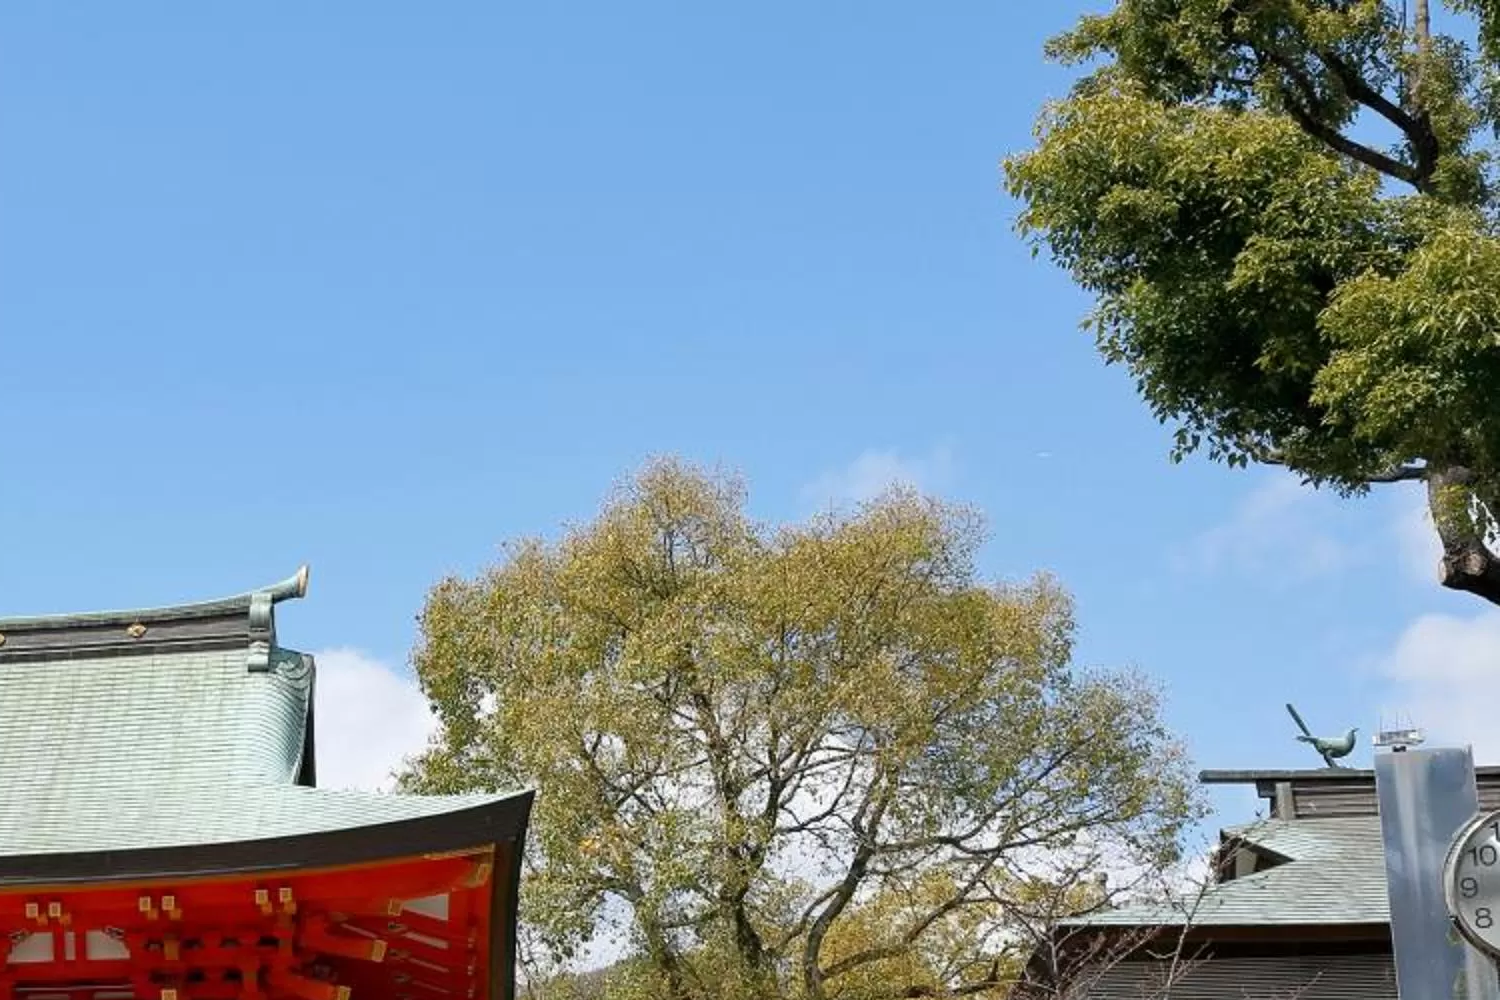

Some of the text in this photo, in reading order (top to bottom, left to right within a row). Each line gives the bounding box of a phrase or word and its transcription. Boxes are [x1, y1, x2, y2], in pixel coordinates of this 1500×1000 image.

[1468, 845, 1497, 867] 10
[1461, 877, 1478, 898] 9
[1475, 907, 1493, 929] 8
